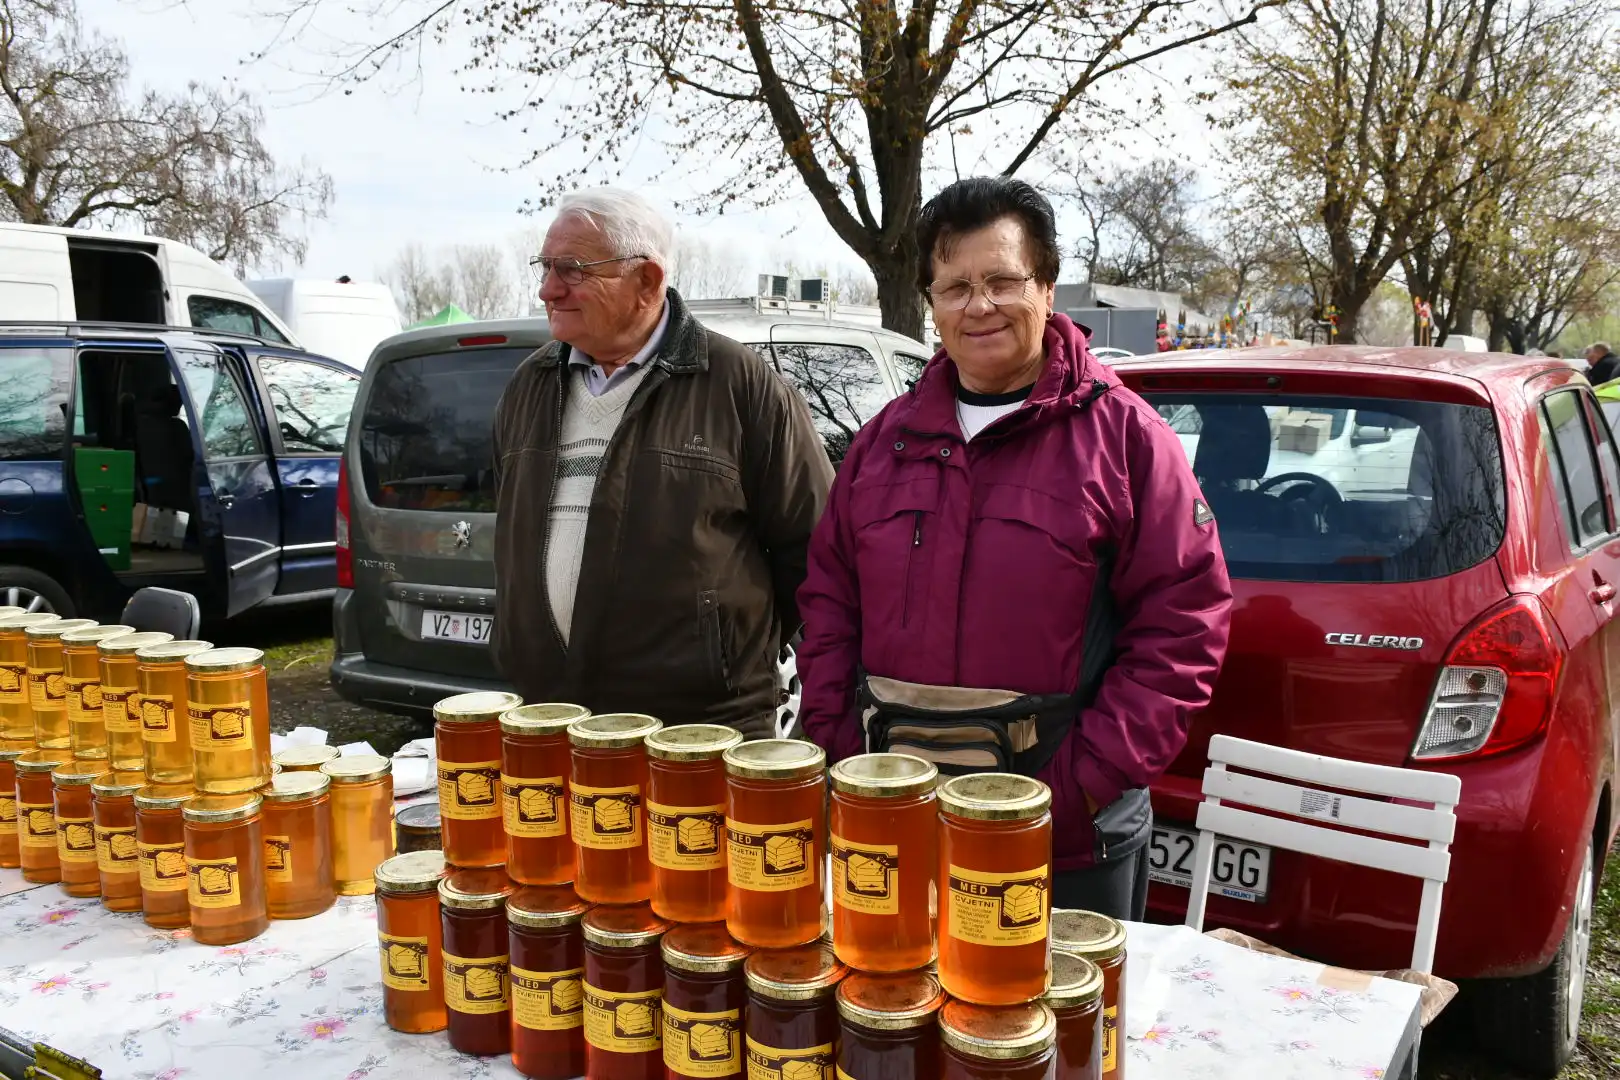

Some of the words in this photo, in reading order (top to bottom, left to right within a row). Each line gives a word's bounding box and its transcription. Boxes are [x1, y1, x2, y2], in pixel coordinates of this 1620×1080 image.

[433, 614, 451, 637] VZ
[465, 617, 492, 640] 197
[1325, 632, 1424, 650] CELERIO
[731, 832, 752, 844] MED
[730, 844, 758, 857] CVJETNI
[1149, 830, 1195, 876] 52
[1213, 843, 1261, 888] GG
[960, 881, 988, 895] MED
[1222, 889, 1252, 899] SUZUKI
[955, 895, 994, 908] CVJETNI
[519, 977, 539, 989] MED
[516, 989, 545, 1000] CVJETNI
[587, 994, 604, 1008] MED
[751, 1050, 768, 1066] MED
